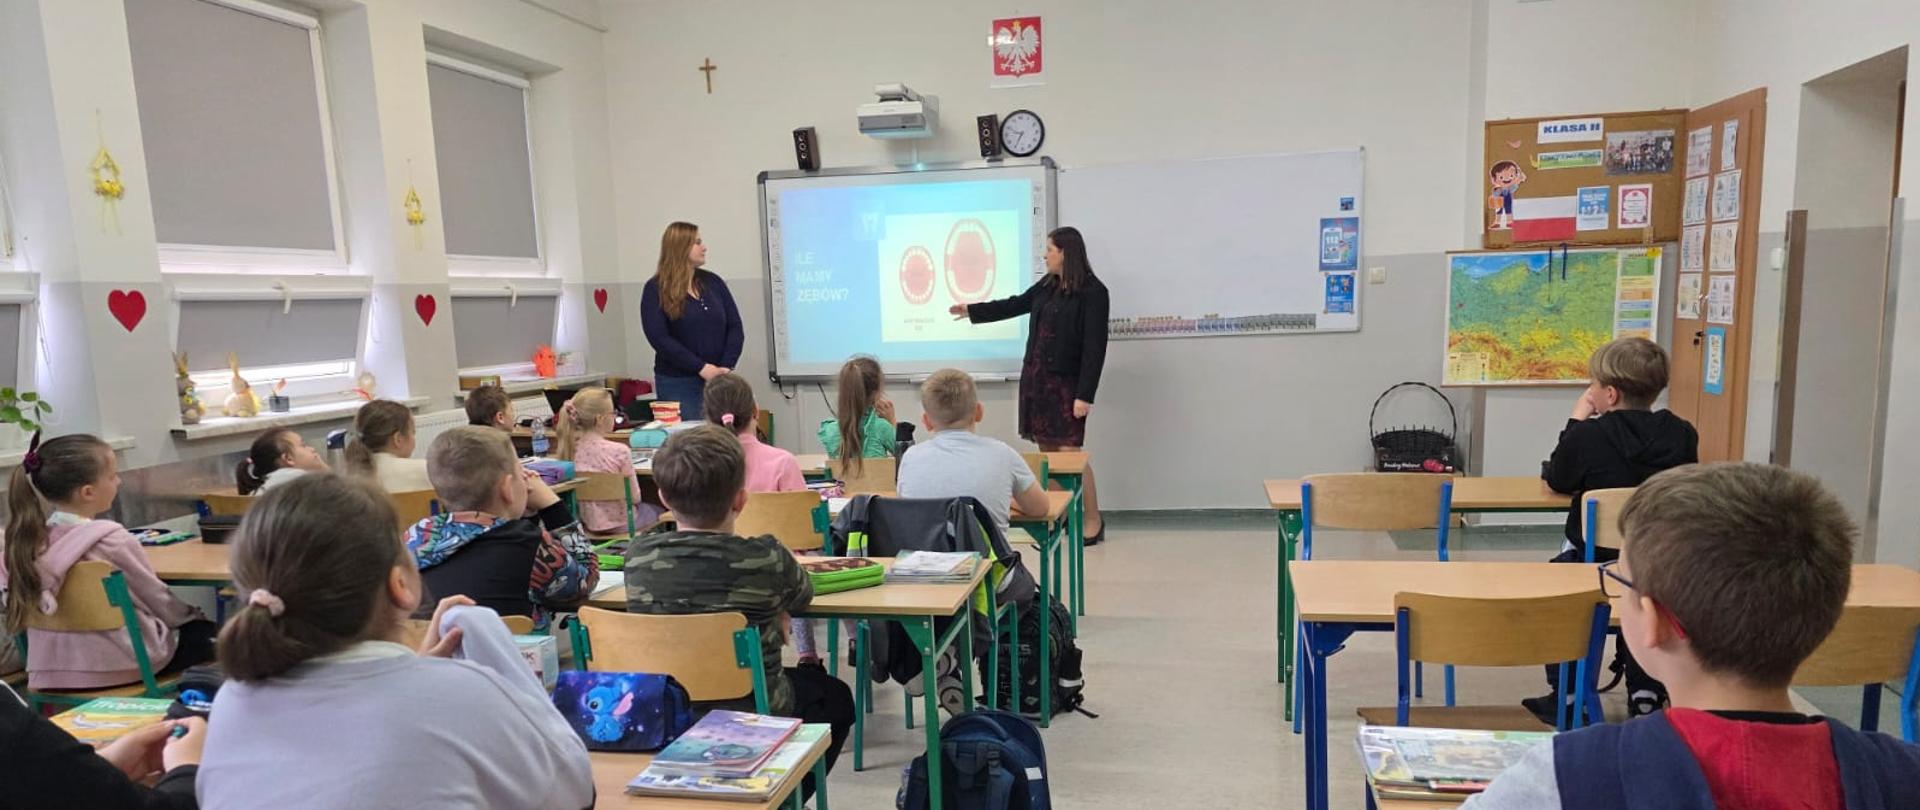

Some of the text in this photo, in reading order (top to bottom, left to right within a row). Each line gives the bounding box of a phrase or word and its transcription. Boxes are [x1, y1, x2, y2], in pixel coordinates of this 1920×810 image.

[1543, 122, 1600, 134] KLASA II
[796, 270, 832, 284] MAMY
